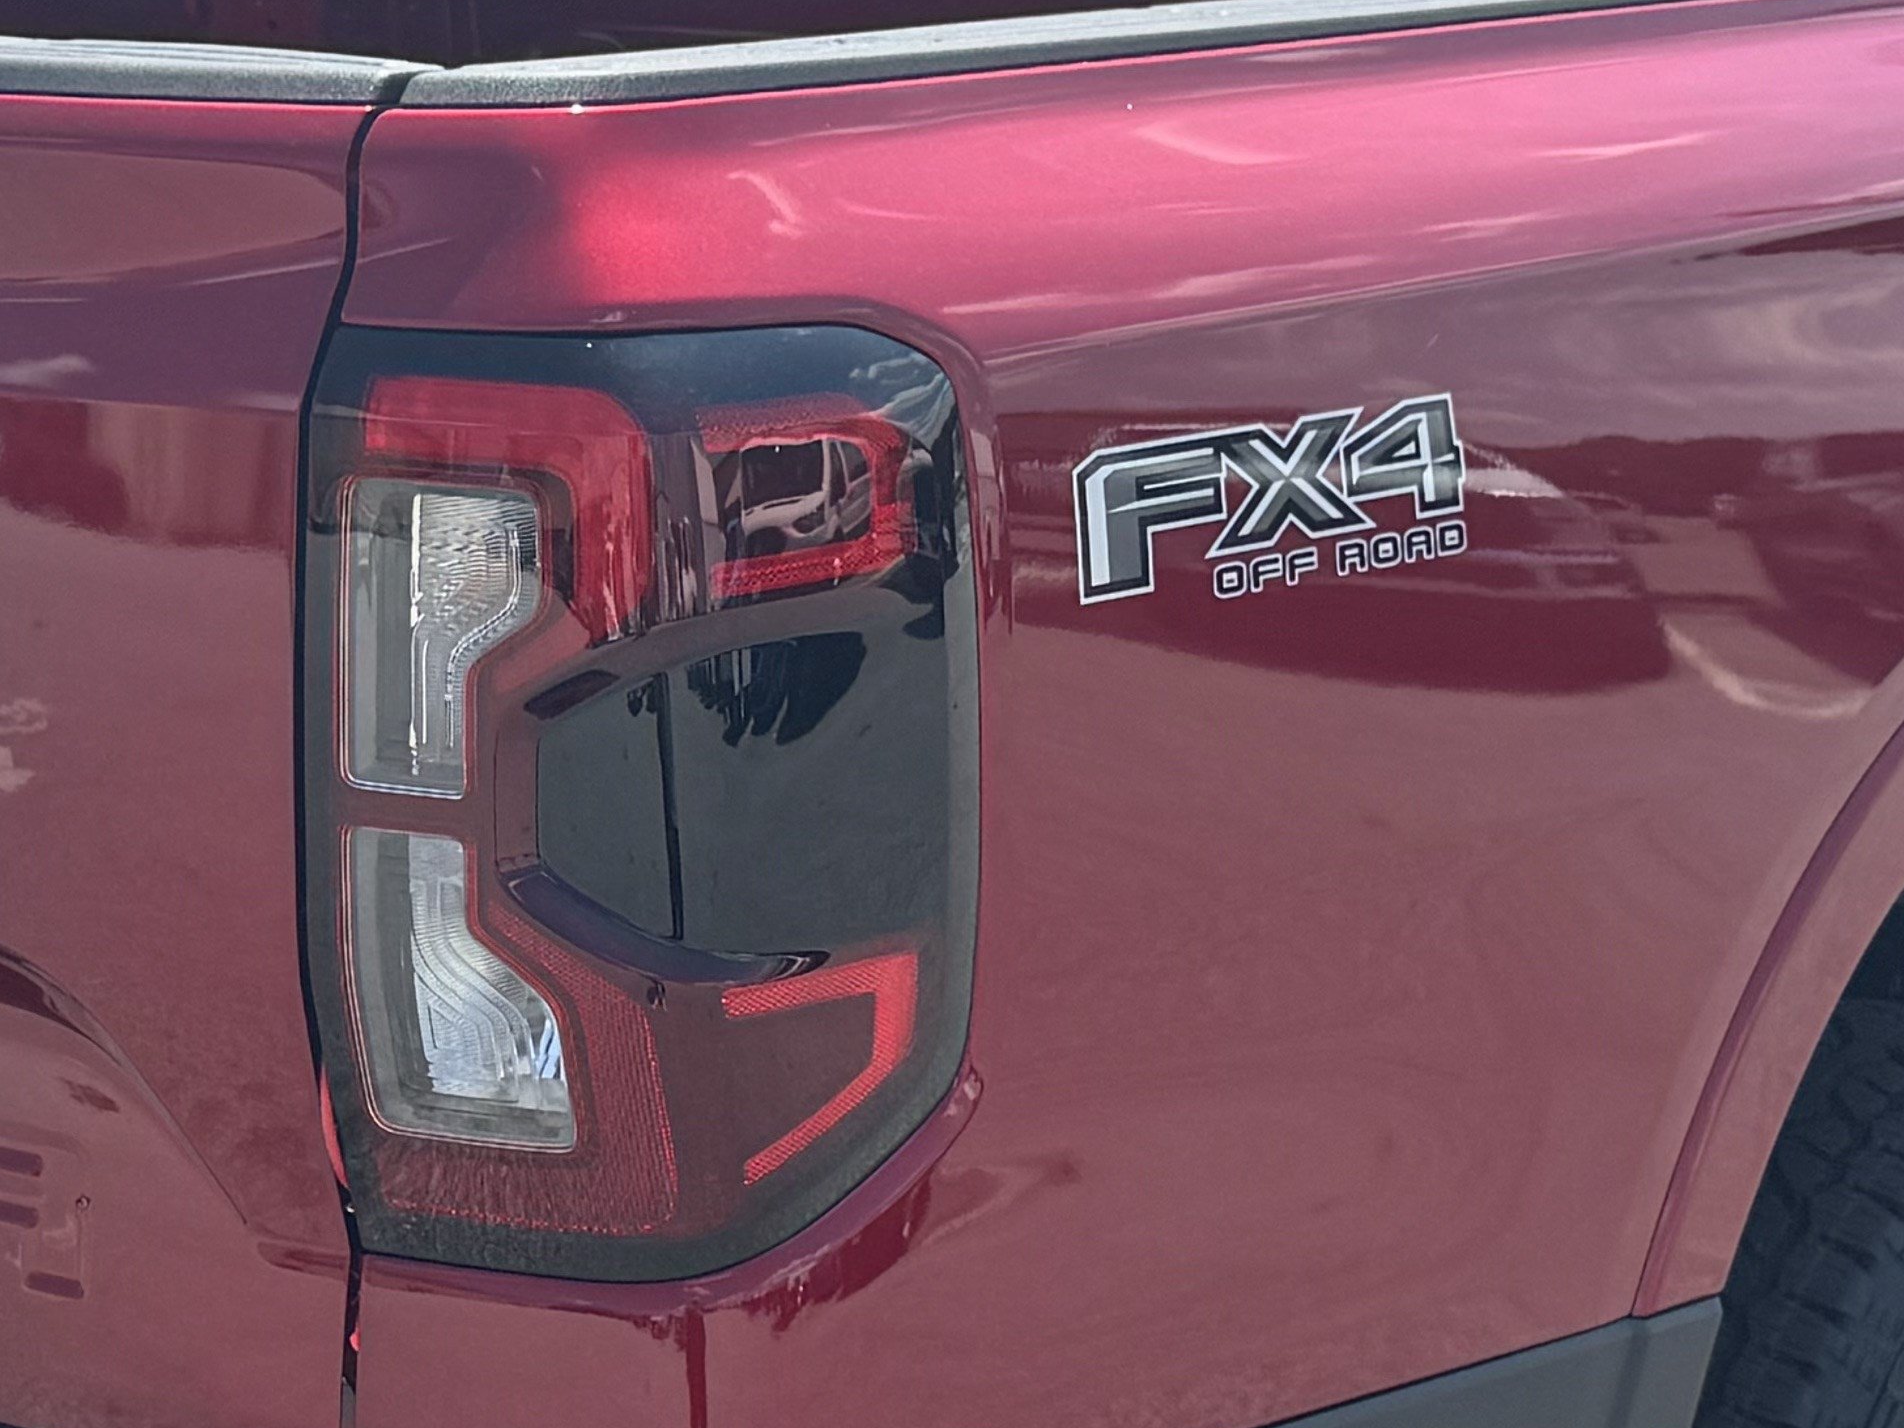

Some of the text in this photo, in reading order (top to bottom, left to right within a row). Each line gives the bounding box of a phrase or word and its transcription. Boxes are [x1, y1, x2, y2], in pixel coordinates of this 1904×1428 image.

[1072, 392, 1465, 605] FX4
[1214, 520, 1468, 599] OFF ROAD
